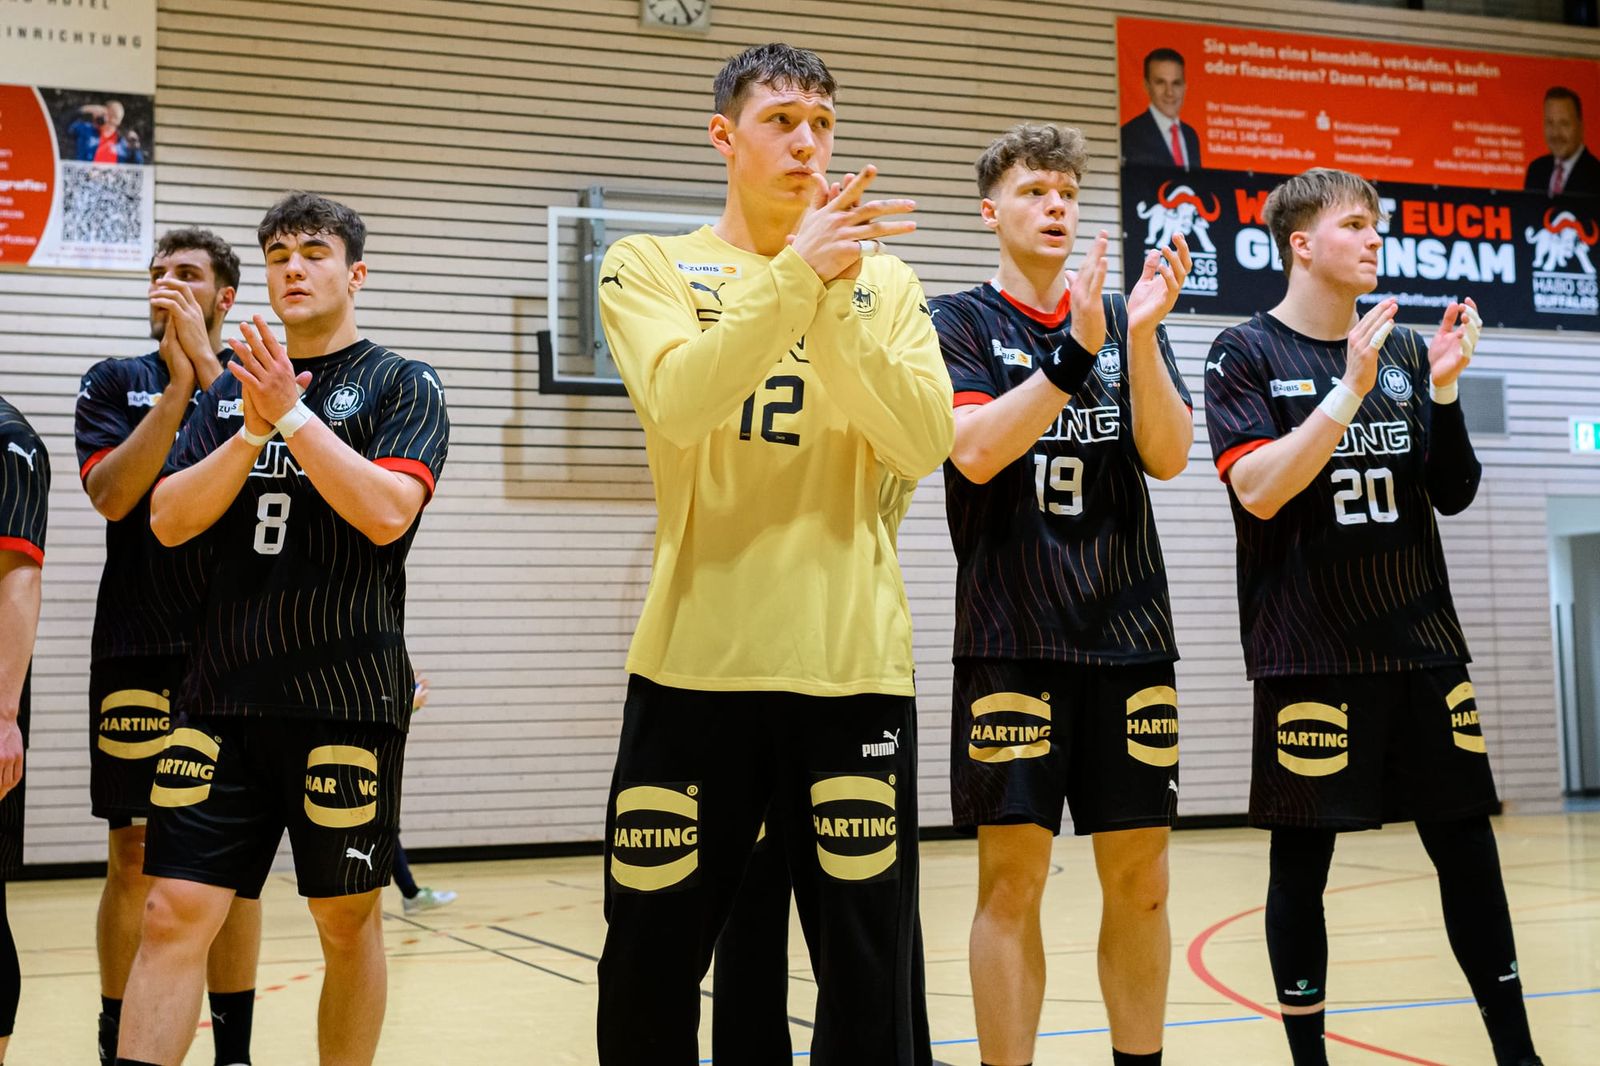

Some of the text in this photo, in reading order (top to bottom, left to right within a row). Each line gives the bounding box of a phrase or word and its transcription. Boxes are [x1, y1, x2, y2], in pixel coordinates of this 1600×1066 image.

[0, 25, 142, 49] INRICHTUNG
[1203, 37, 1500, 78] Sie wollen eine Immobilie verkaufen, kaufen
[1204, 59, 1238, 75] oder
[1240, 61, 1327, 83] finanzieren?
[1329, 69, 1366, 86] Dann
[1367, 73, 1405, 90] rufen
[1405, 75, 1428, 92] Sie
[1429, 80, 1455, 95] uns
[1402, 199, 1513, 241] EUCH
[1194, 258, 1218, 277] SG
[1235, 227, 1516, 284] GNSAM
[739, 375, 805, 447] 12
[1034, 453, 1084, 516] 19
[1330, 466, 1399, 525] 20
[253, 493, 292, 554] 8
[99, 717, 170, 731] HARTING
[970, 724, 1052, 742] HARTING
[1127, 718, 1179, 735] HARTIN
[1277, 730, 1348, 748] HARTING
[156, 758, 215, 780] ARTING
